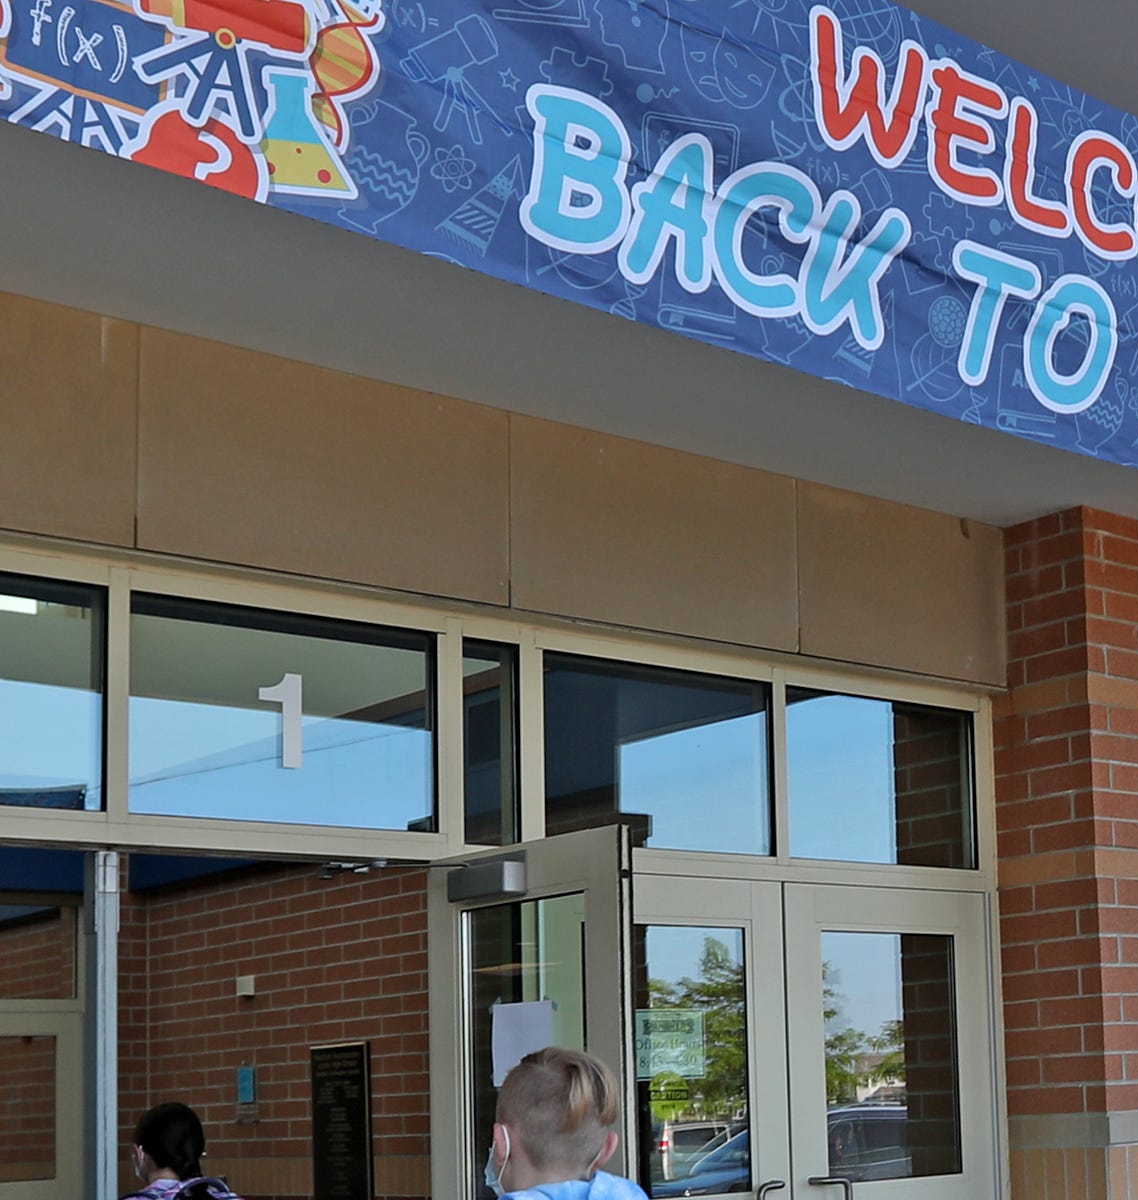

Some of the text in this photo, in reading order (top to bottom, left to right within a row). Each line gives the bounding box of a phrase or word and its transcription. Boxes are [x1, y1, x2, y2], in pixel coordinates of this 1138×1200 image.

[519, 83, 911, 351] BACK
[953, 240, 1118, 414] TO
[259, 673, 302, 768] 1
